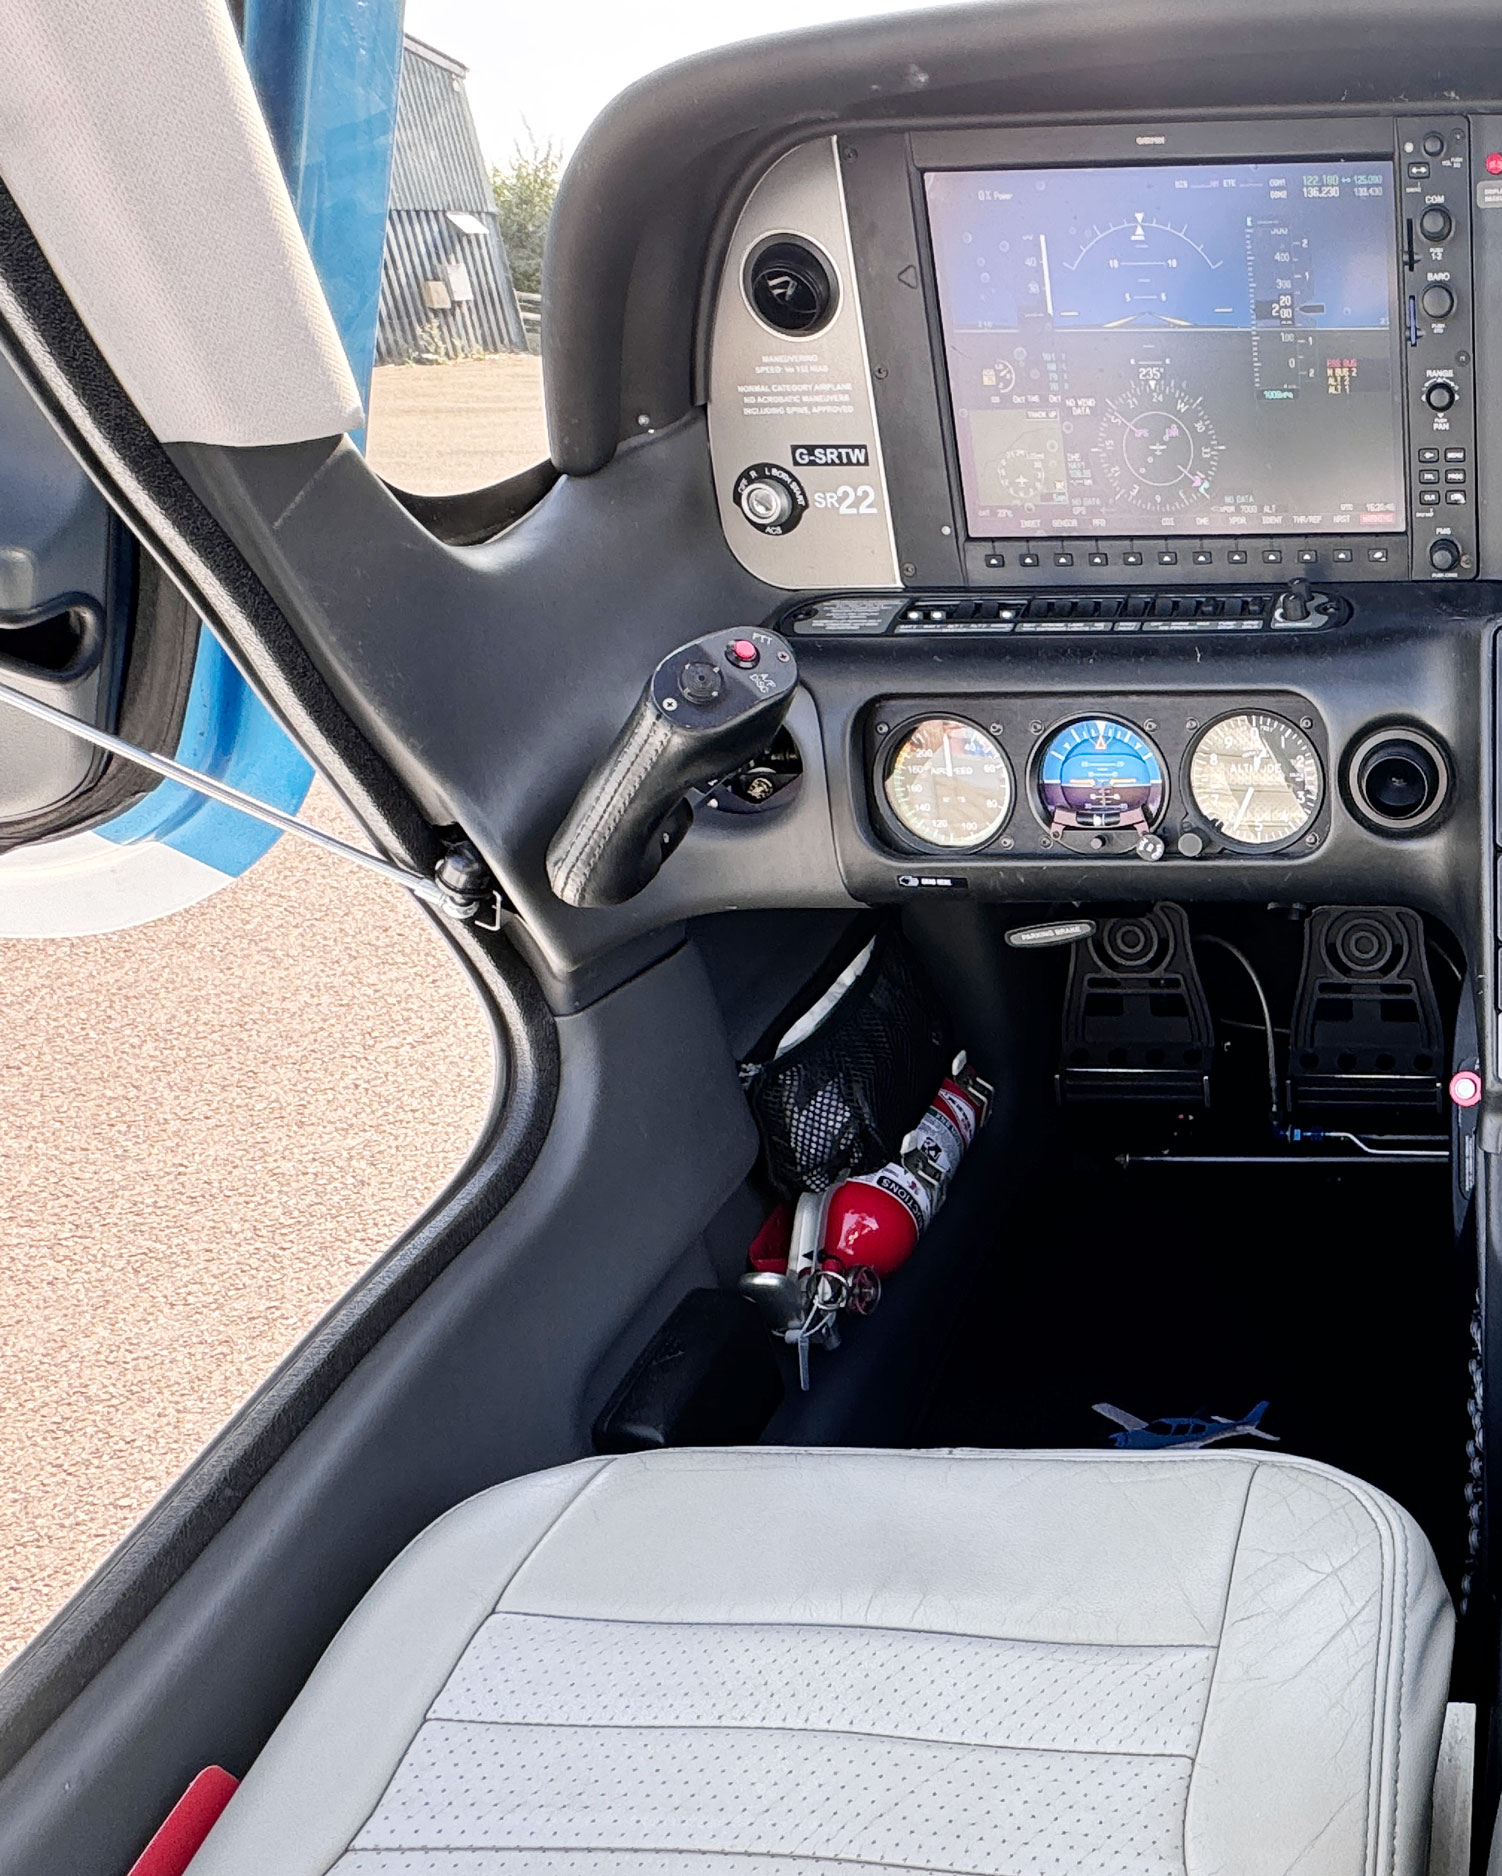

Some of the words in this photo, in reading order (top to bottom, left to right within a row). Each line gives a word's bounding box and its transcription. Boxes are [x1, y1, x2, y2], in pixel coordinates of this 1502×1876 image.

[1425, 195, 1445, 204] COM
[1427, 272, 1450, 281] BARO
[1426, 369, 1454, 378] RANGE
[812, 405, 853, 413] APPROVED
[1433, 422, 1449, 431] PAN
[795, 448, 866, 464] G-SRTW
[814, 485, 878, 515] SR22
[752, 632, 773, 645] PTT
[1209, 753, 1218, 765] 8
[1296, 755, 1305, 767] 2
[1297, 791, 1306, 803] 3
